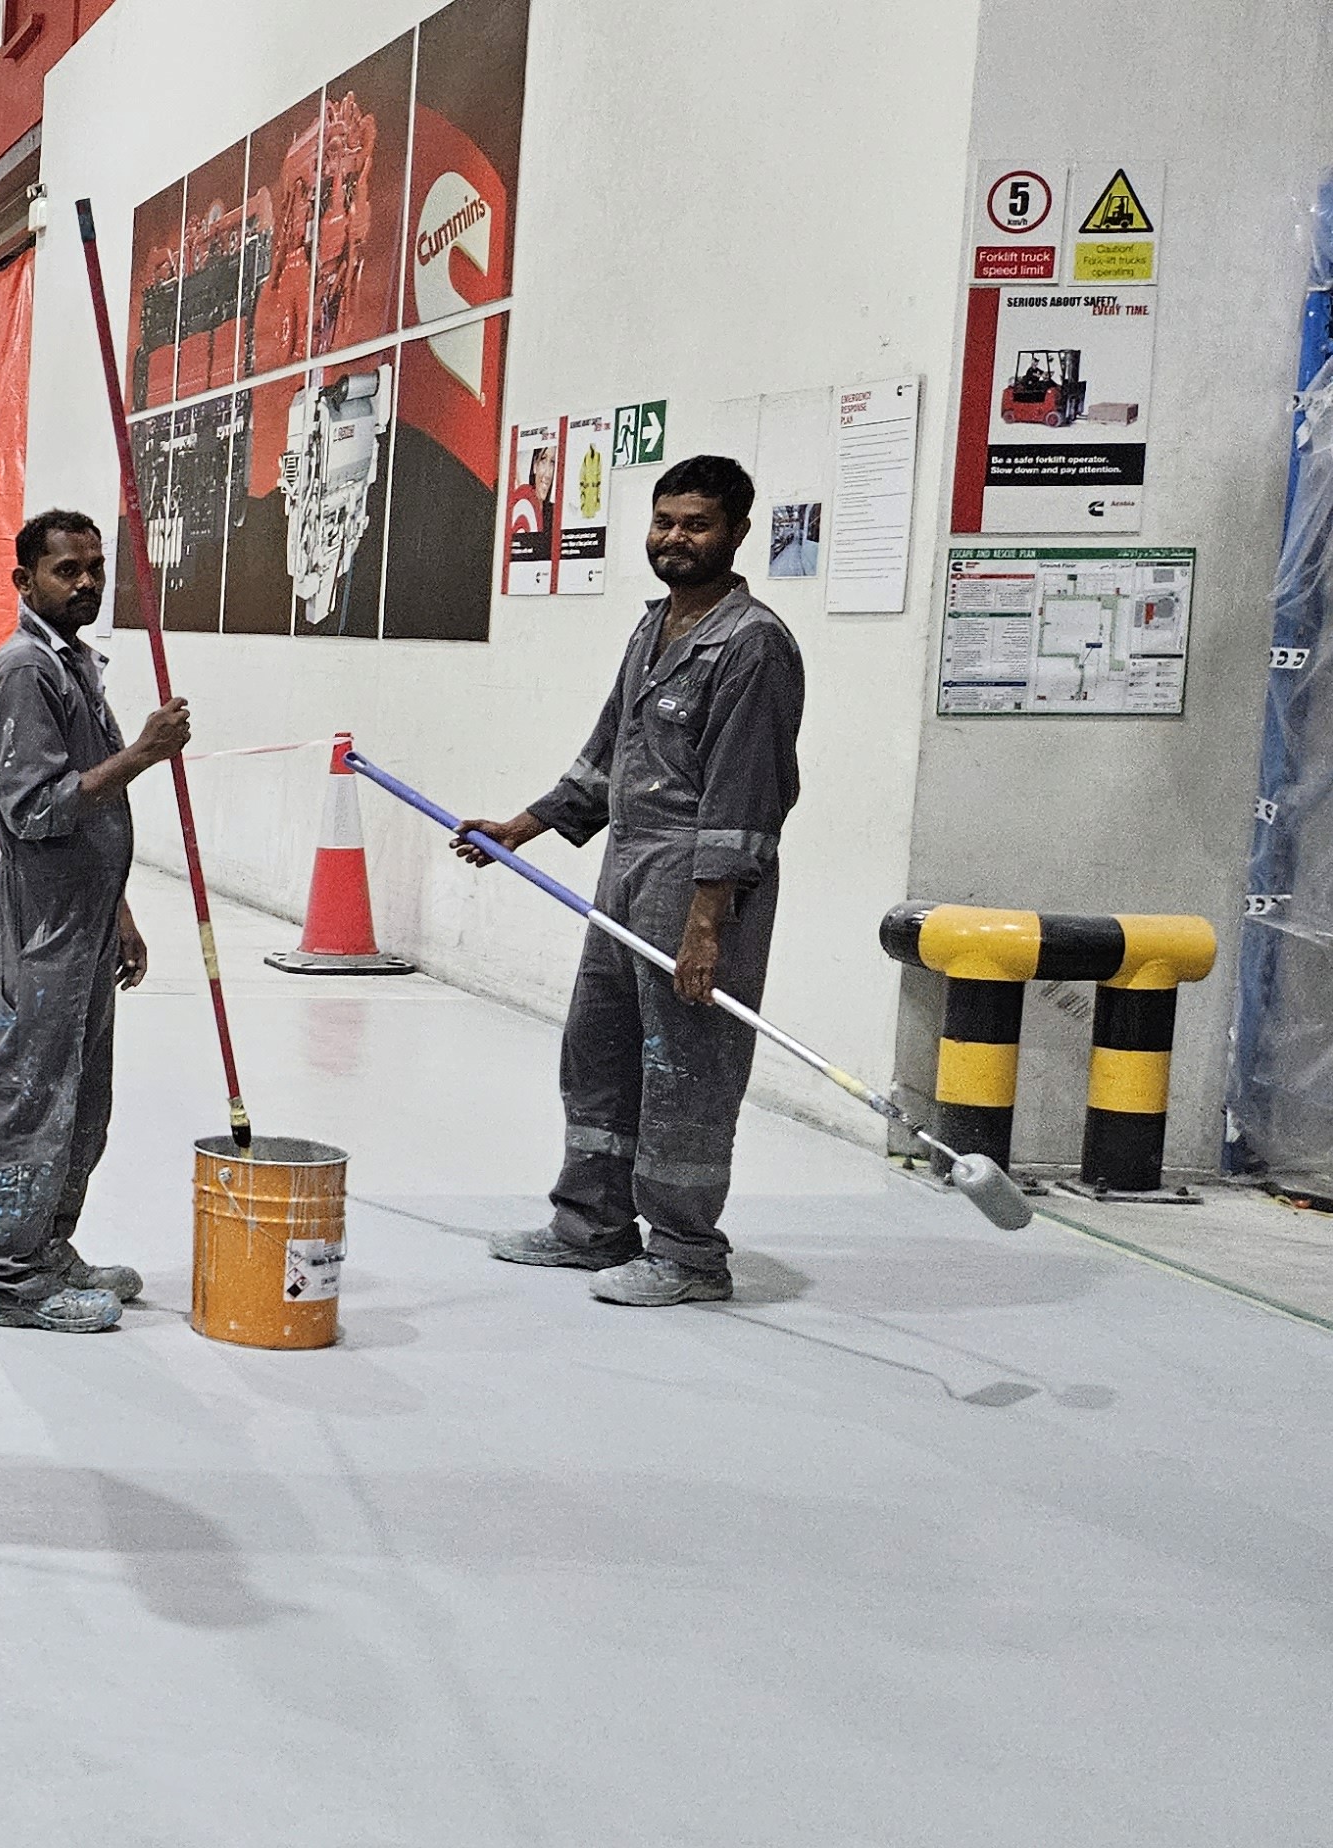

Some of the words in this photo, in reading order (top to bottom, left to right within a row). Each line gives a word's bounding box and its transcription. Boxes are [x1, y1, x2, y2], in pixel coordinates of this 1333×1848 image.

[1008, 181, 1030, 217] 5
[416, 195, 486, 267] Cummins
[979, 251, 1018, 263] Forklift
[1021, 251, 1051, 262] truck
[982, 265, 1017, 277] speed
[1020, 264, 1044, 275] limit
[1007, 296, 1048, 308] SERIOUS
[1049, 296, 1082, 307] ABOUT
[991, 456, 1004, 464] Be
[1013, 455, 1034, 464] safe
[1035, 455, 1066, 464] forklift
[1068, 456, 1110, 466] operator.
[990, 466, 1013, 474] Slow
[1014, 466, 1039, 474] down
[1040, 466, 1059, 474] and
[1060, 467, 1076, 476] pay
[1078, 466, 1122, 474] attention.
